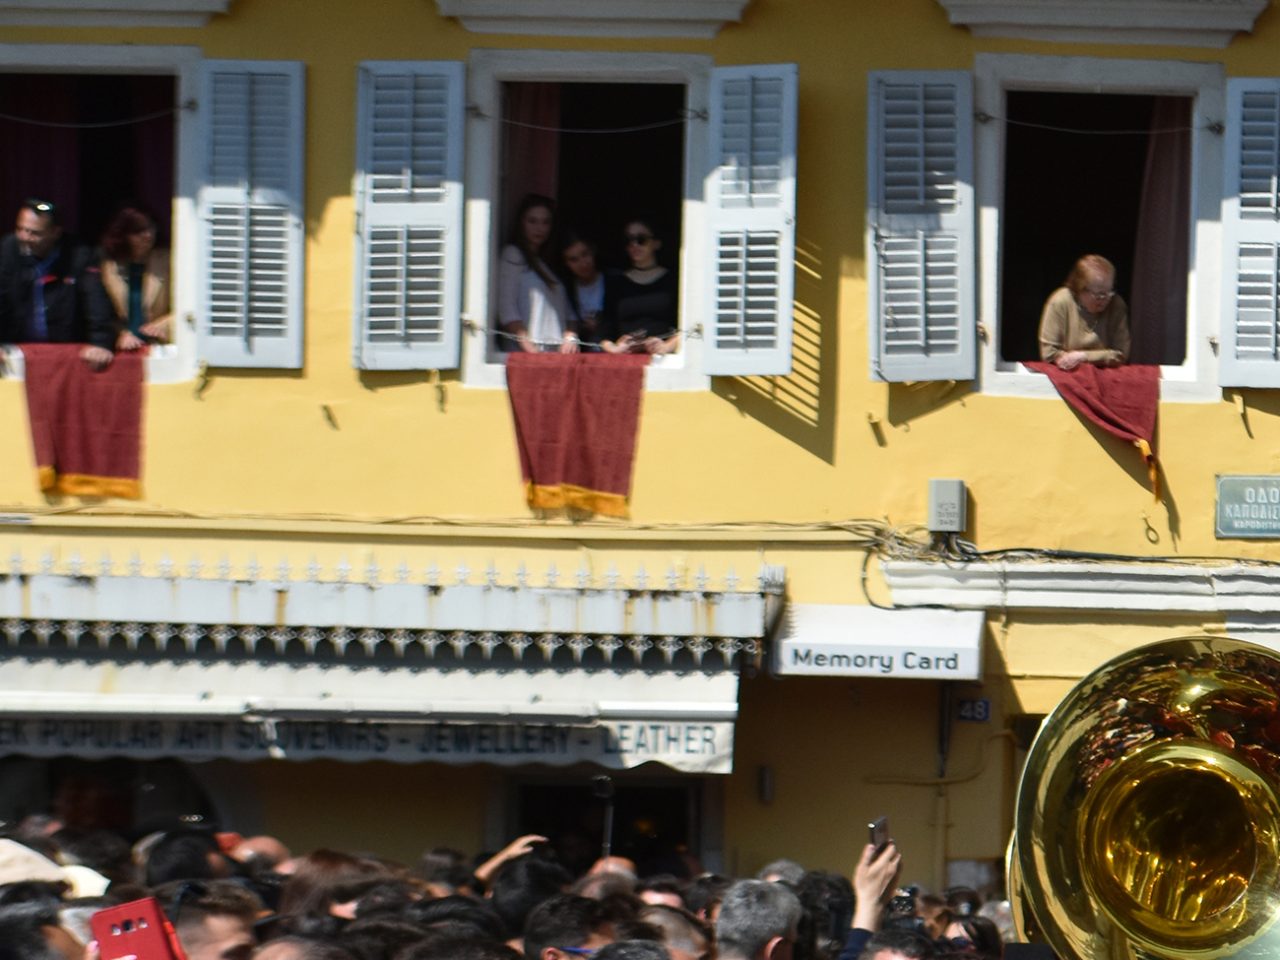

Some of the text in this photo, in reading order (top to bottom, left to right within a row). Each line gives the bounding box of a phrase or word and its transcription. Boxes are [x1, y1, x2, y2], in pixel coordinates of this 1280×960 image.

[793, 649, 960, 673] Memory Card
[960, 701, 986, 719] 48
[41, 719, 162, 748] POPULAR
[174, 720, 224, 750] ART
[417, 724, 572, 753] JEWELLERY
[603, 724, 717, 755] LEATHER
